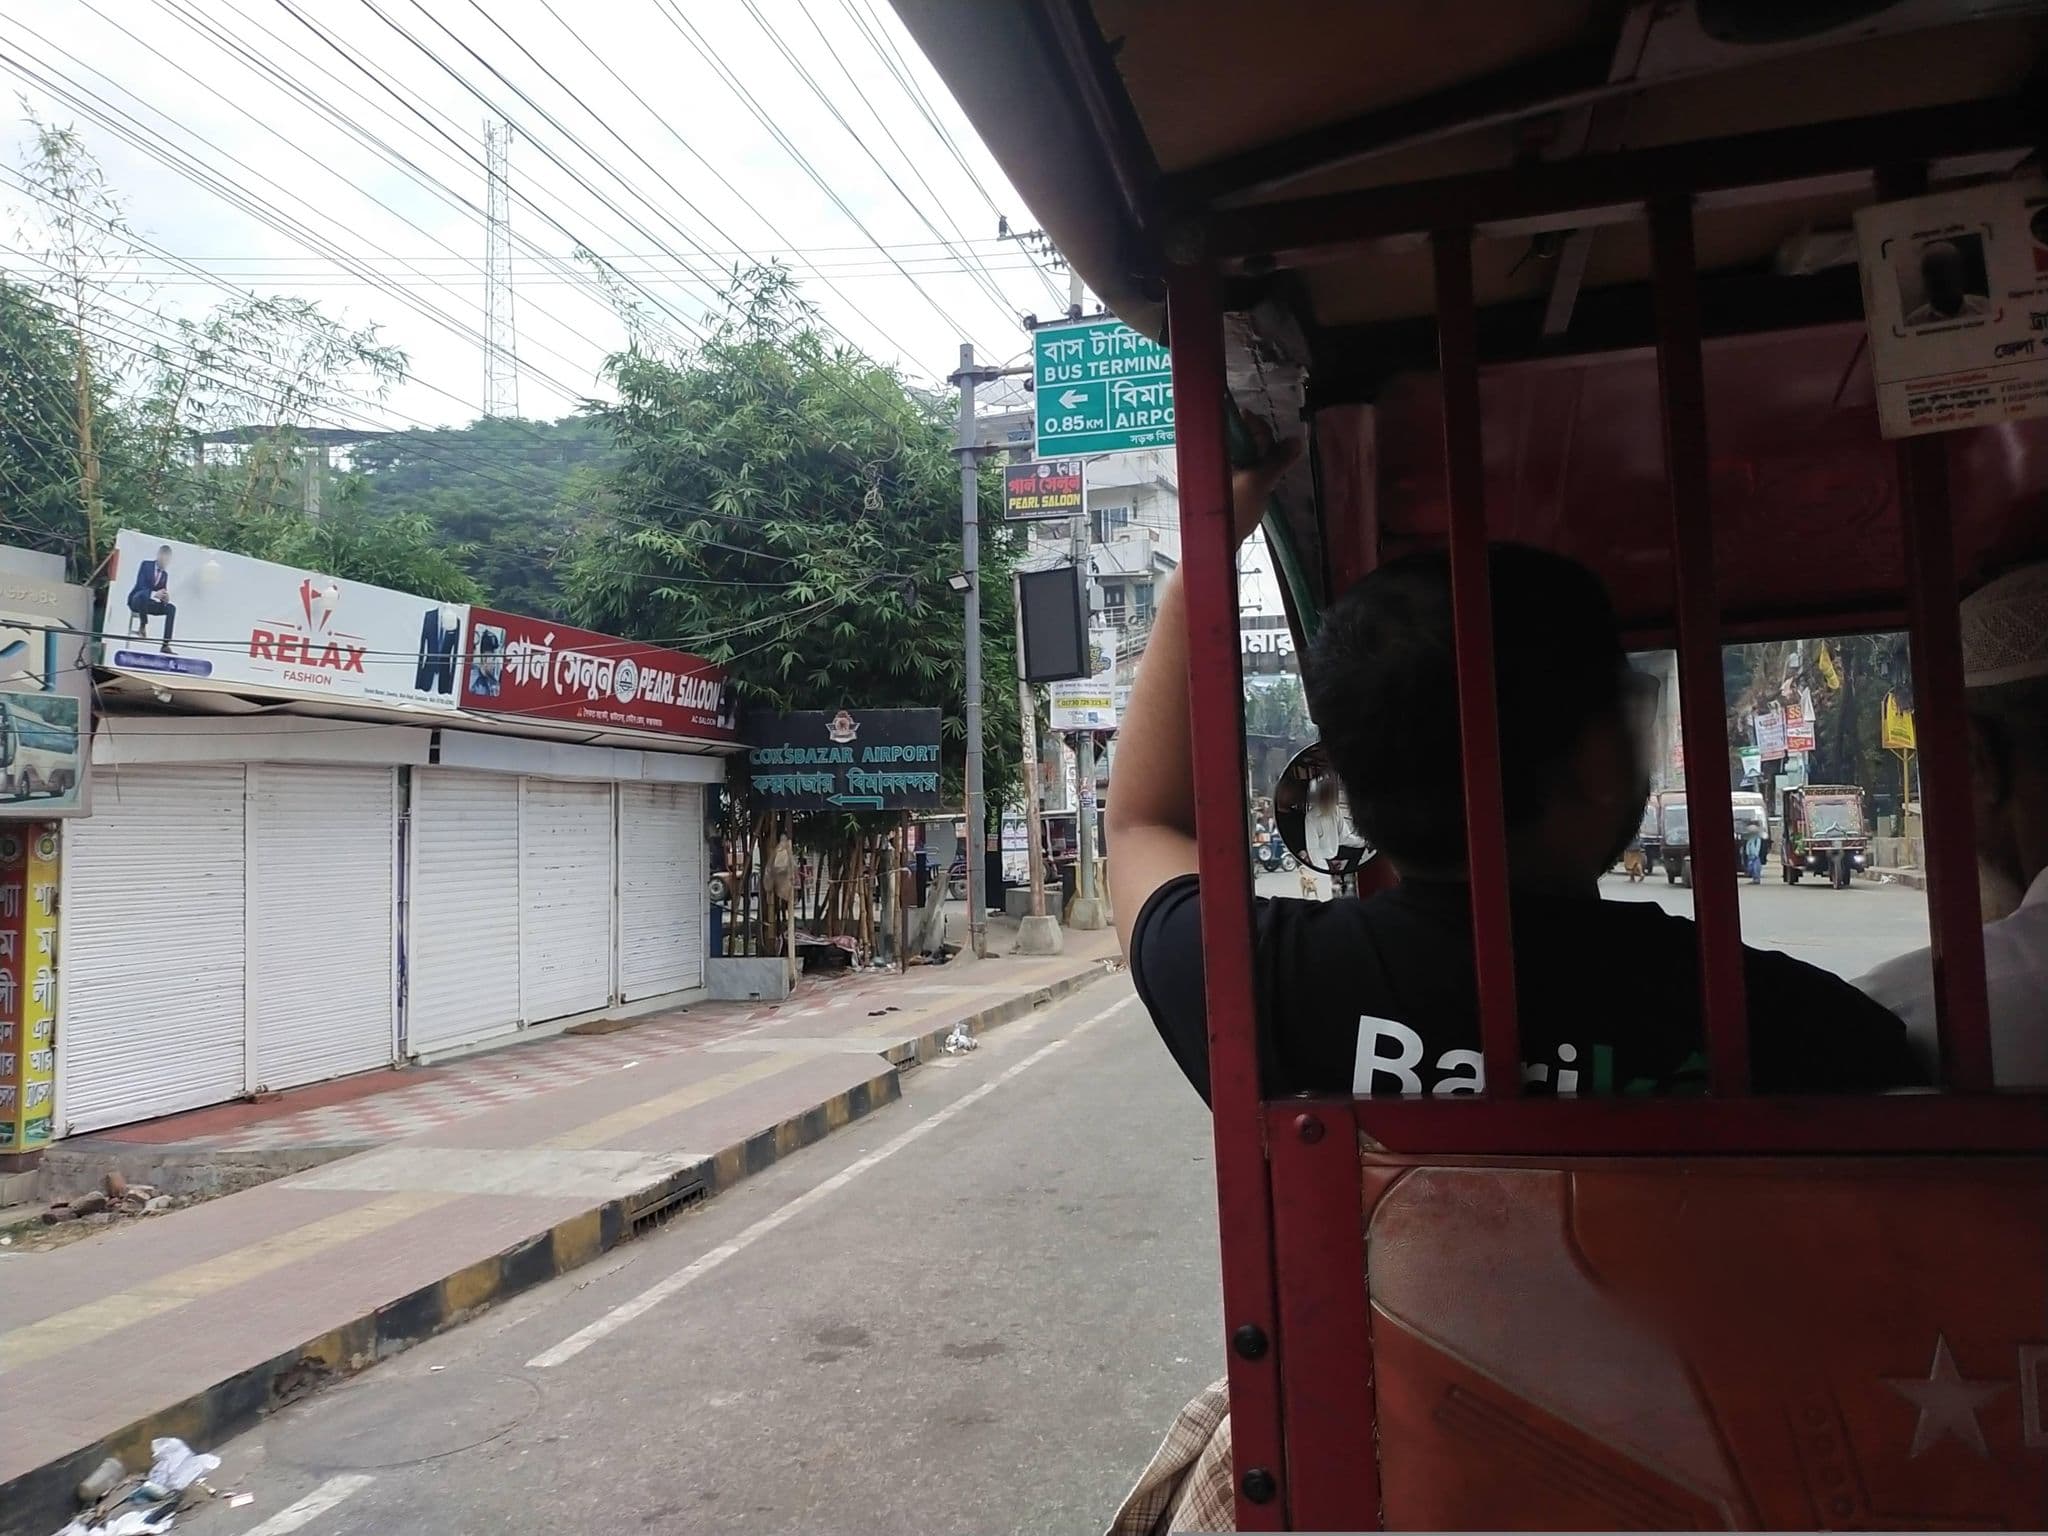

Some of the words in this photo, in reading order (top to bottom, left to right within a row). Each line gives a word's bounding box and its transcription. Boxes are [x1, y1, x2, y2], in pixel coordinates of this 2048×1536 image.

[1041, 339, 1085, 363] বাস
[1044, 364, 1083, 382] BUS
[1008, 496, 1040, 510] PEARL
[1041, 494, 1080, 508] SALOON
[249, 629, 366, 673] RELAX
[283, 670, 332, 685] FASHION
[554, 651, 616, 701] সেলুন
[636, 667, 676, 704] PEARL
[676, 675, 721, 711] SALOON
[861, 745, 940, 763] AIRPORT
[750, 771, 836, 796] কক্সবাজার
[845, 767, 940, 796] বিমানবন্দর
